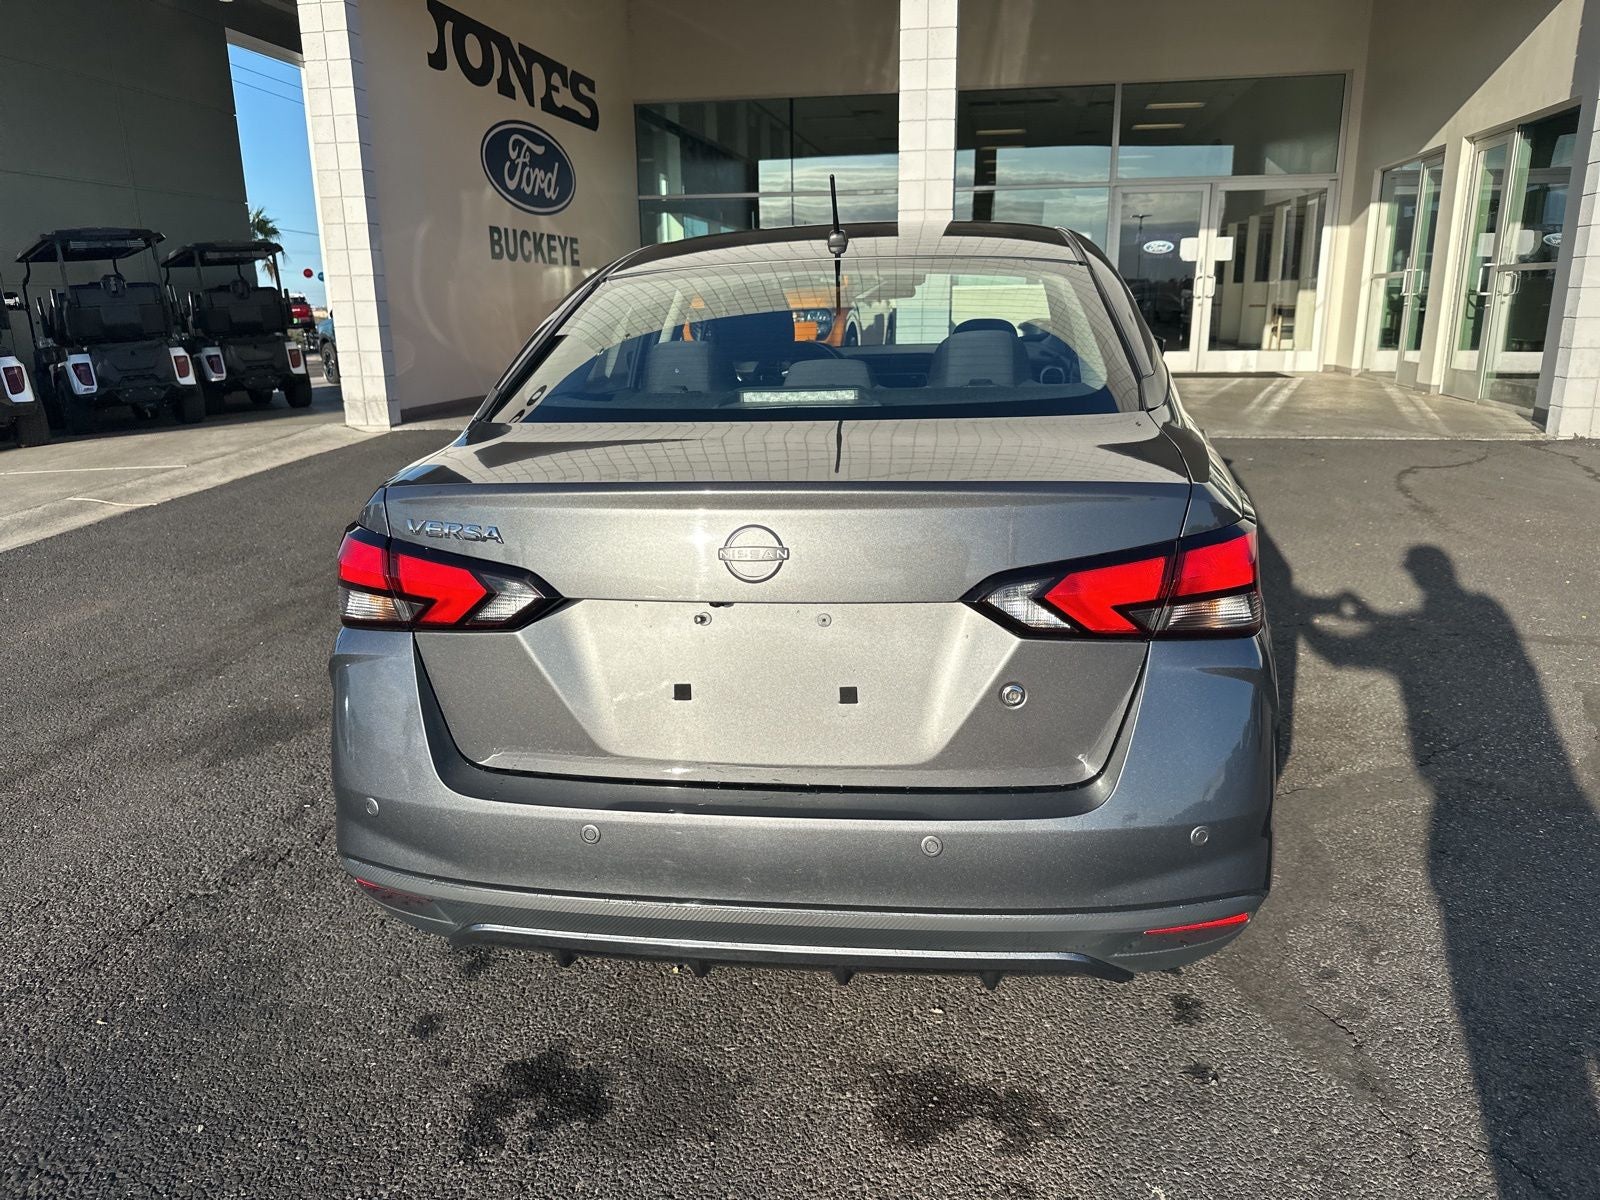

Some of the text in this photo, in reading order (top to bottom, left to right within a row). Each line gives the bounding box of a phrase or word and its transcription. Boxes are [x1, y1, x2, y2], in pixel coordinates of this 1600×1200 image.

[427, 0, 599, 132] JONES
[504, 134, 558, 200] Ford
[489, 226, 580, 267] BUCKEYE
[407, 519, 504, 544] VERSA
[719, 549, 788, 560] NISSAN
